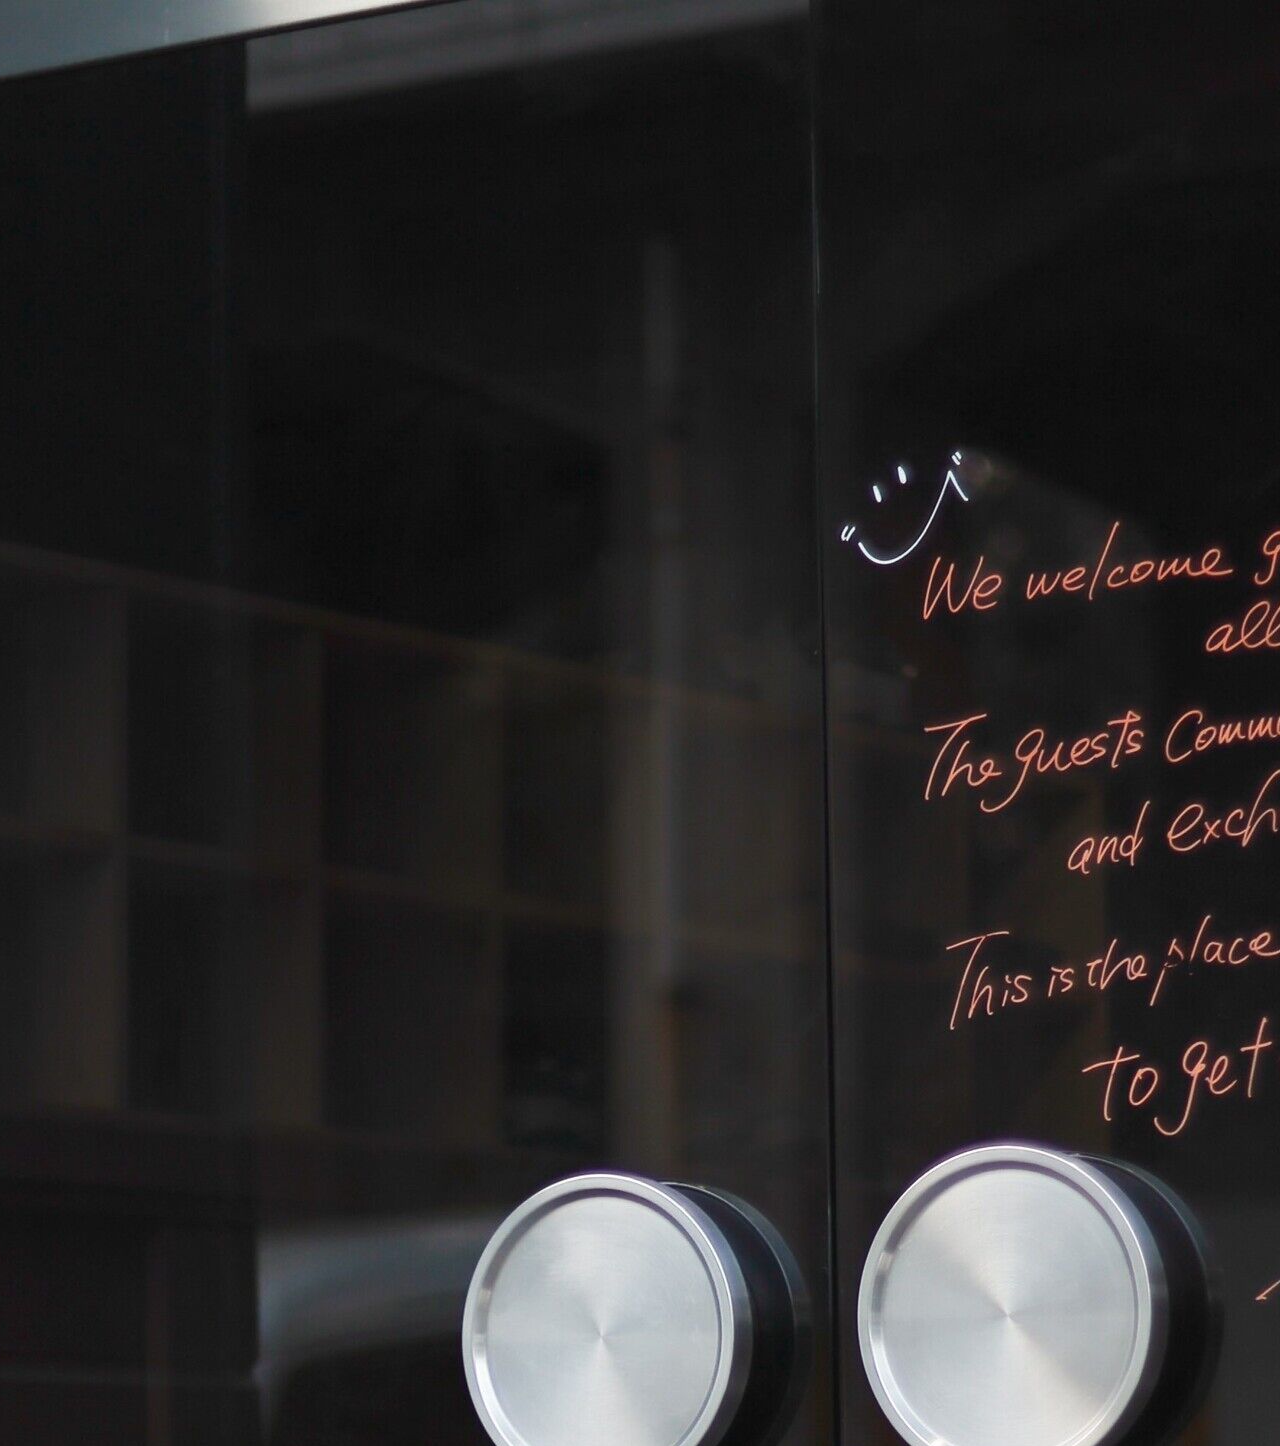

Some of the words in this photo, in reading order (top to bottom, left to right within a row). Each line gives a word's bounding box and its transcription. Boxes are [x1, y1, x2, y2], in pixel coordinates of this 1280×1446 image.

[923, 554, 1003, 621] We
[1025, 522, 1234, 601] welcome
[923, 713, 1005, 800] The
[978, 709, 1145, 815] guests
[1067, 801, 1150, 875] and
[946, 929, 1033, 1031] This
[1046, 953, 1075, 996] is
[1085, 937, 1150, 988] the
[1153, 1015, 1273, 1136] get
